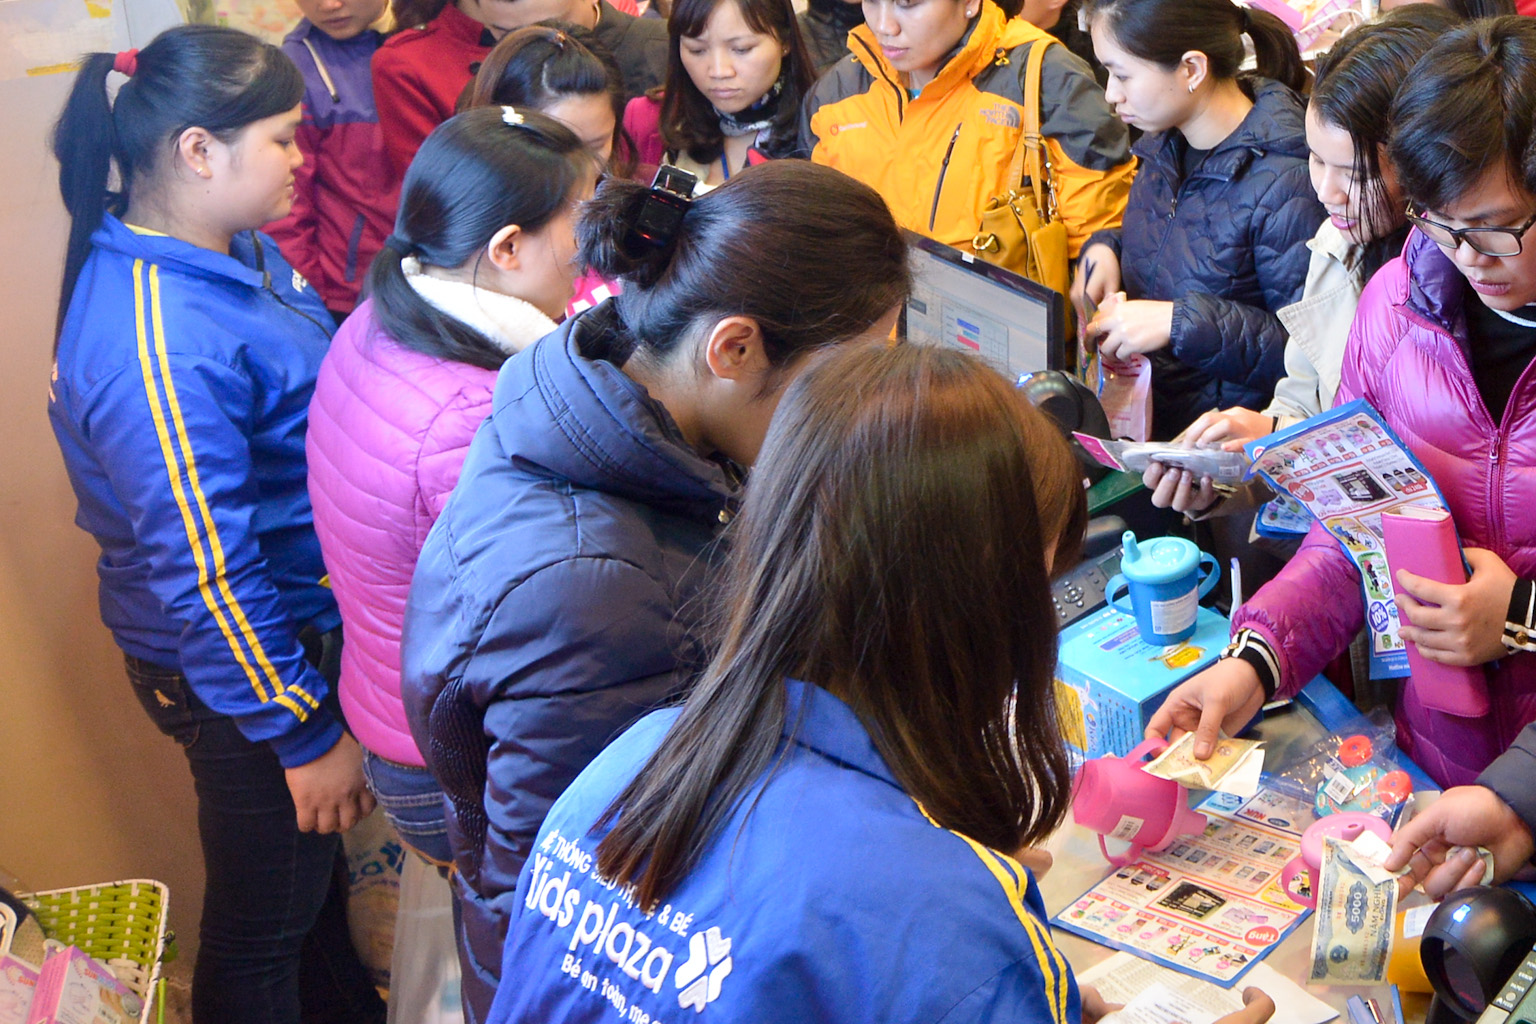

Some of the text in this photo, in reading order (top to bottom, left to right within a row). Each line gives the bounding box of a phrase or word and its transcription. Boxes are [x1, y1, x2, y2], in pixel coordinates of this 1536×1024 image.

[1244, 808, 1267, 821] NUK
[552, 835, 592, 874] THỐNG
[657, 904, 672, 926] &
[669, 910, 694, 937] BÉ
[1351, 891, 1362, 923] 5000
[569, 900, 675, 994] plaza
[1248, 930, 1277, 943] Tặng
[561, 953, 583, 979] Bé
[580, 970, 598, 992] an
